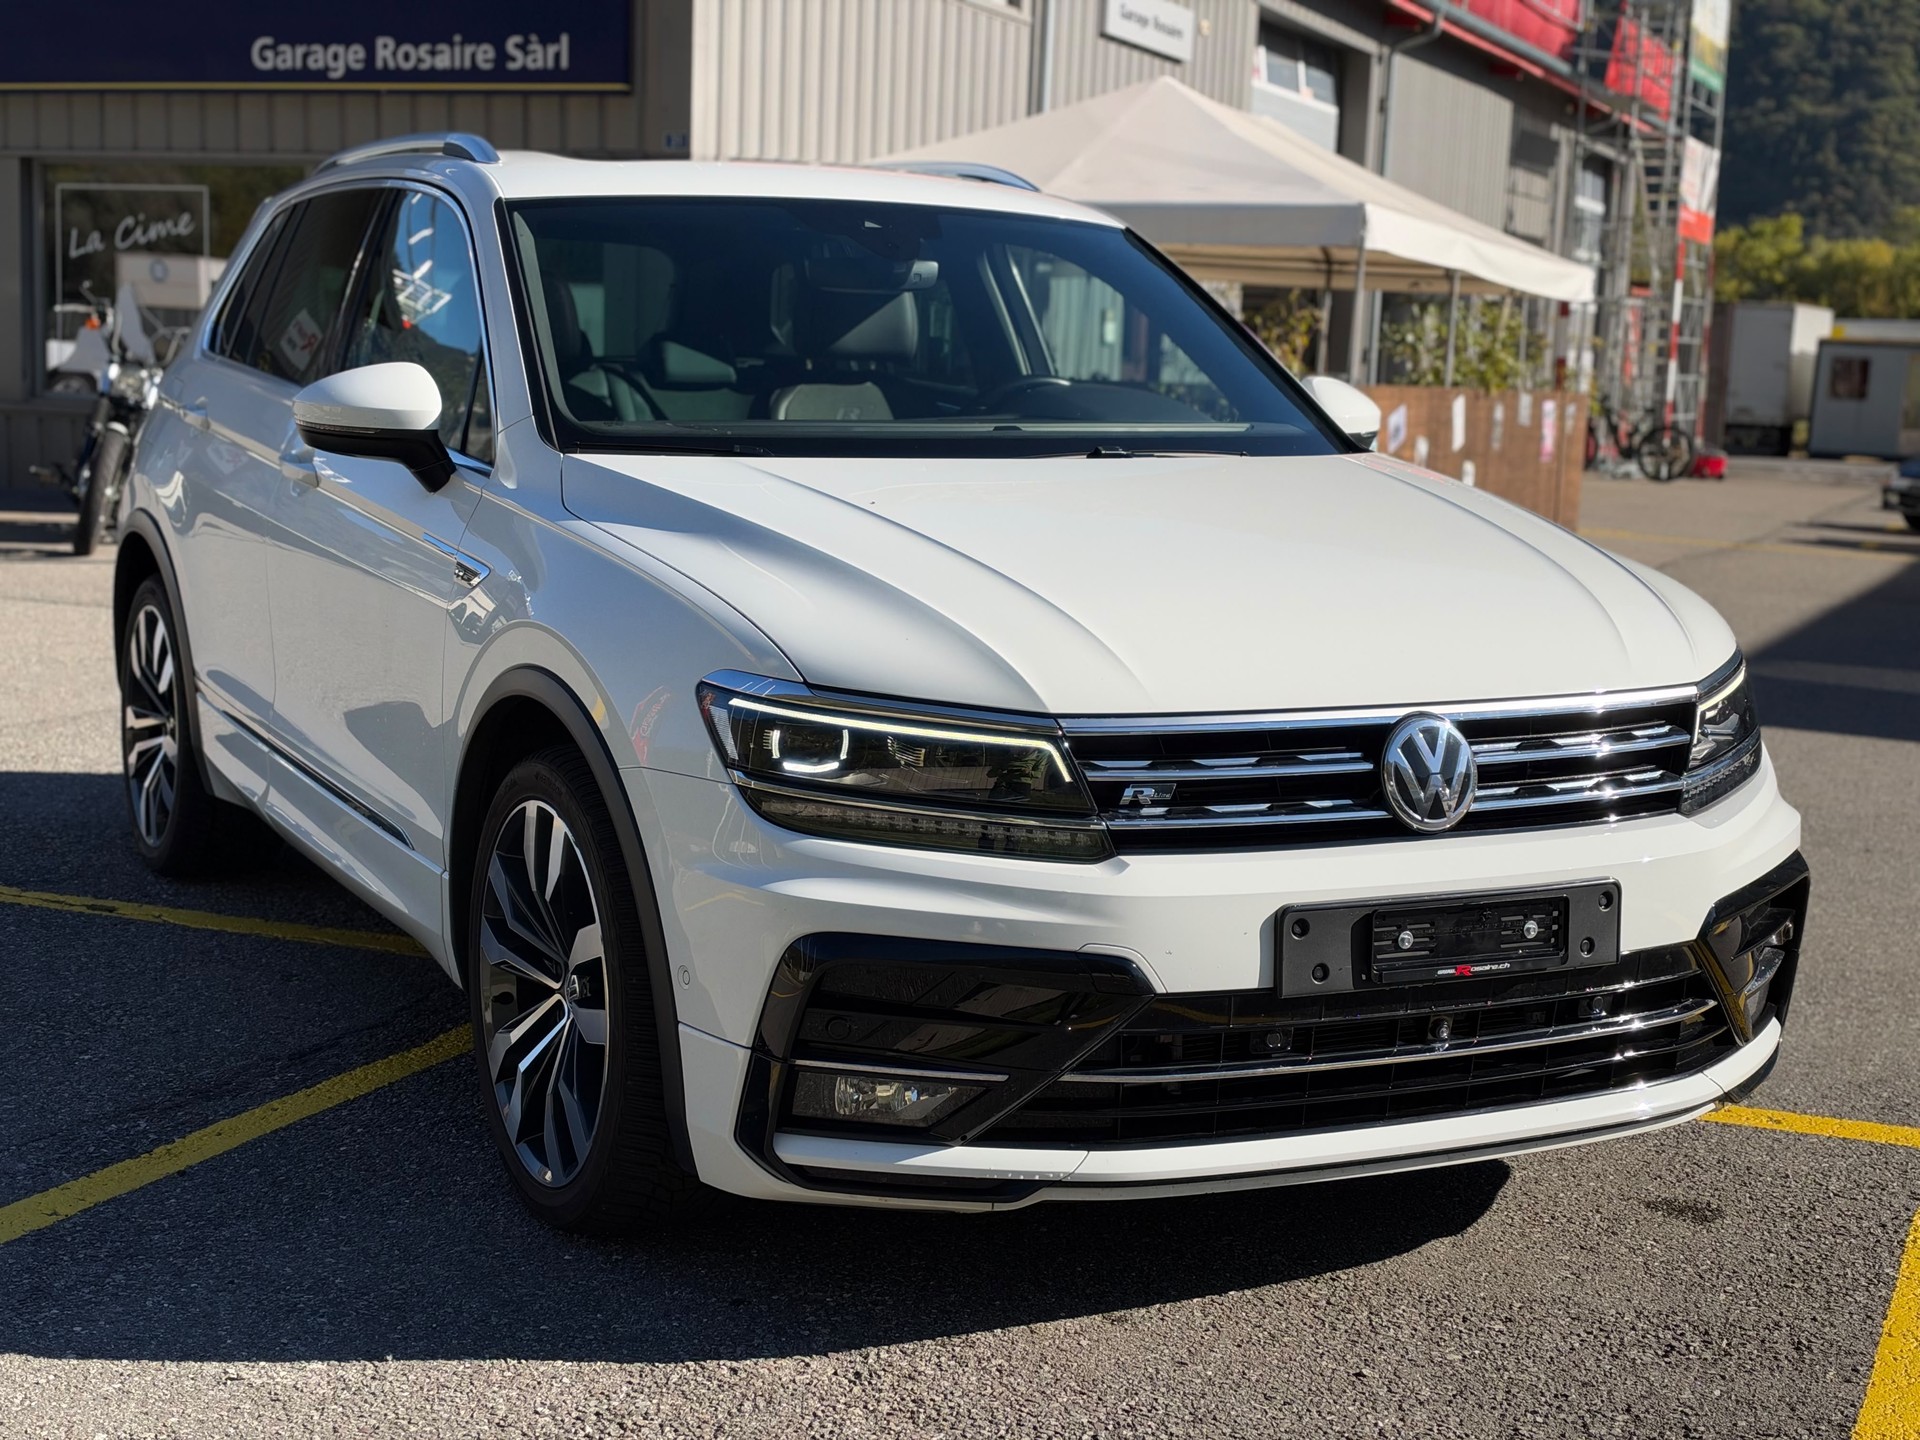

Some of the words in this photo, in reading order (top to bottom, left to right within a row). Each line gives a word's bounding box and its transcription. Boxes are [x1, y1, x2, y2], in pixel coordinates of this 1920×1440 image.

[250, 36, 367, 80] Garage
[374, 33, 496, 71] Rosaire
[504, 32, 571, 71] Sàrl
[69, 226, 106, 259] La
[114, 211, 195, 250] Cime
[1119, 787, 1155, 805] R
